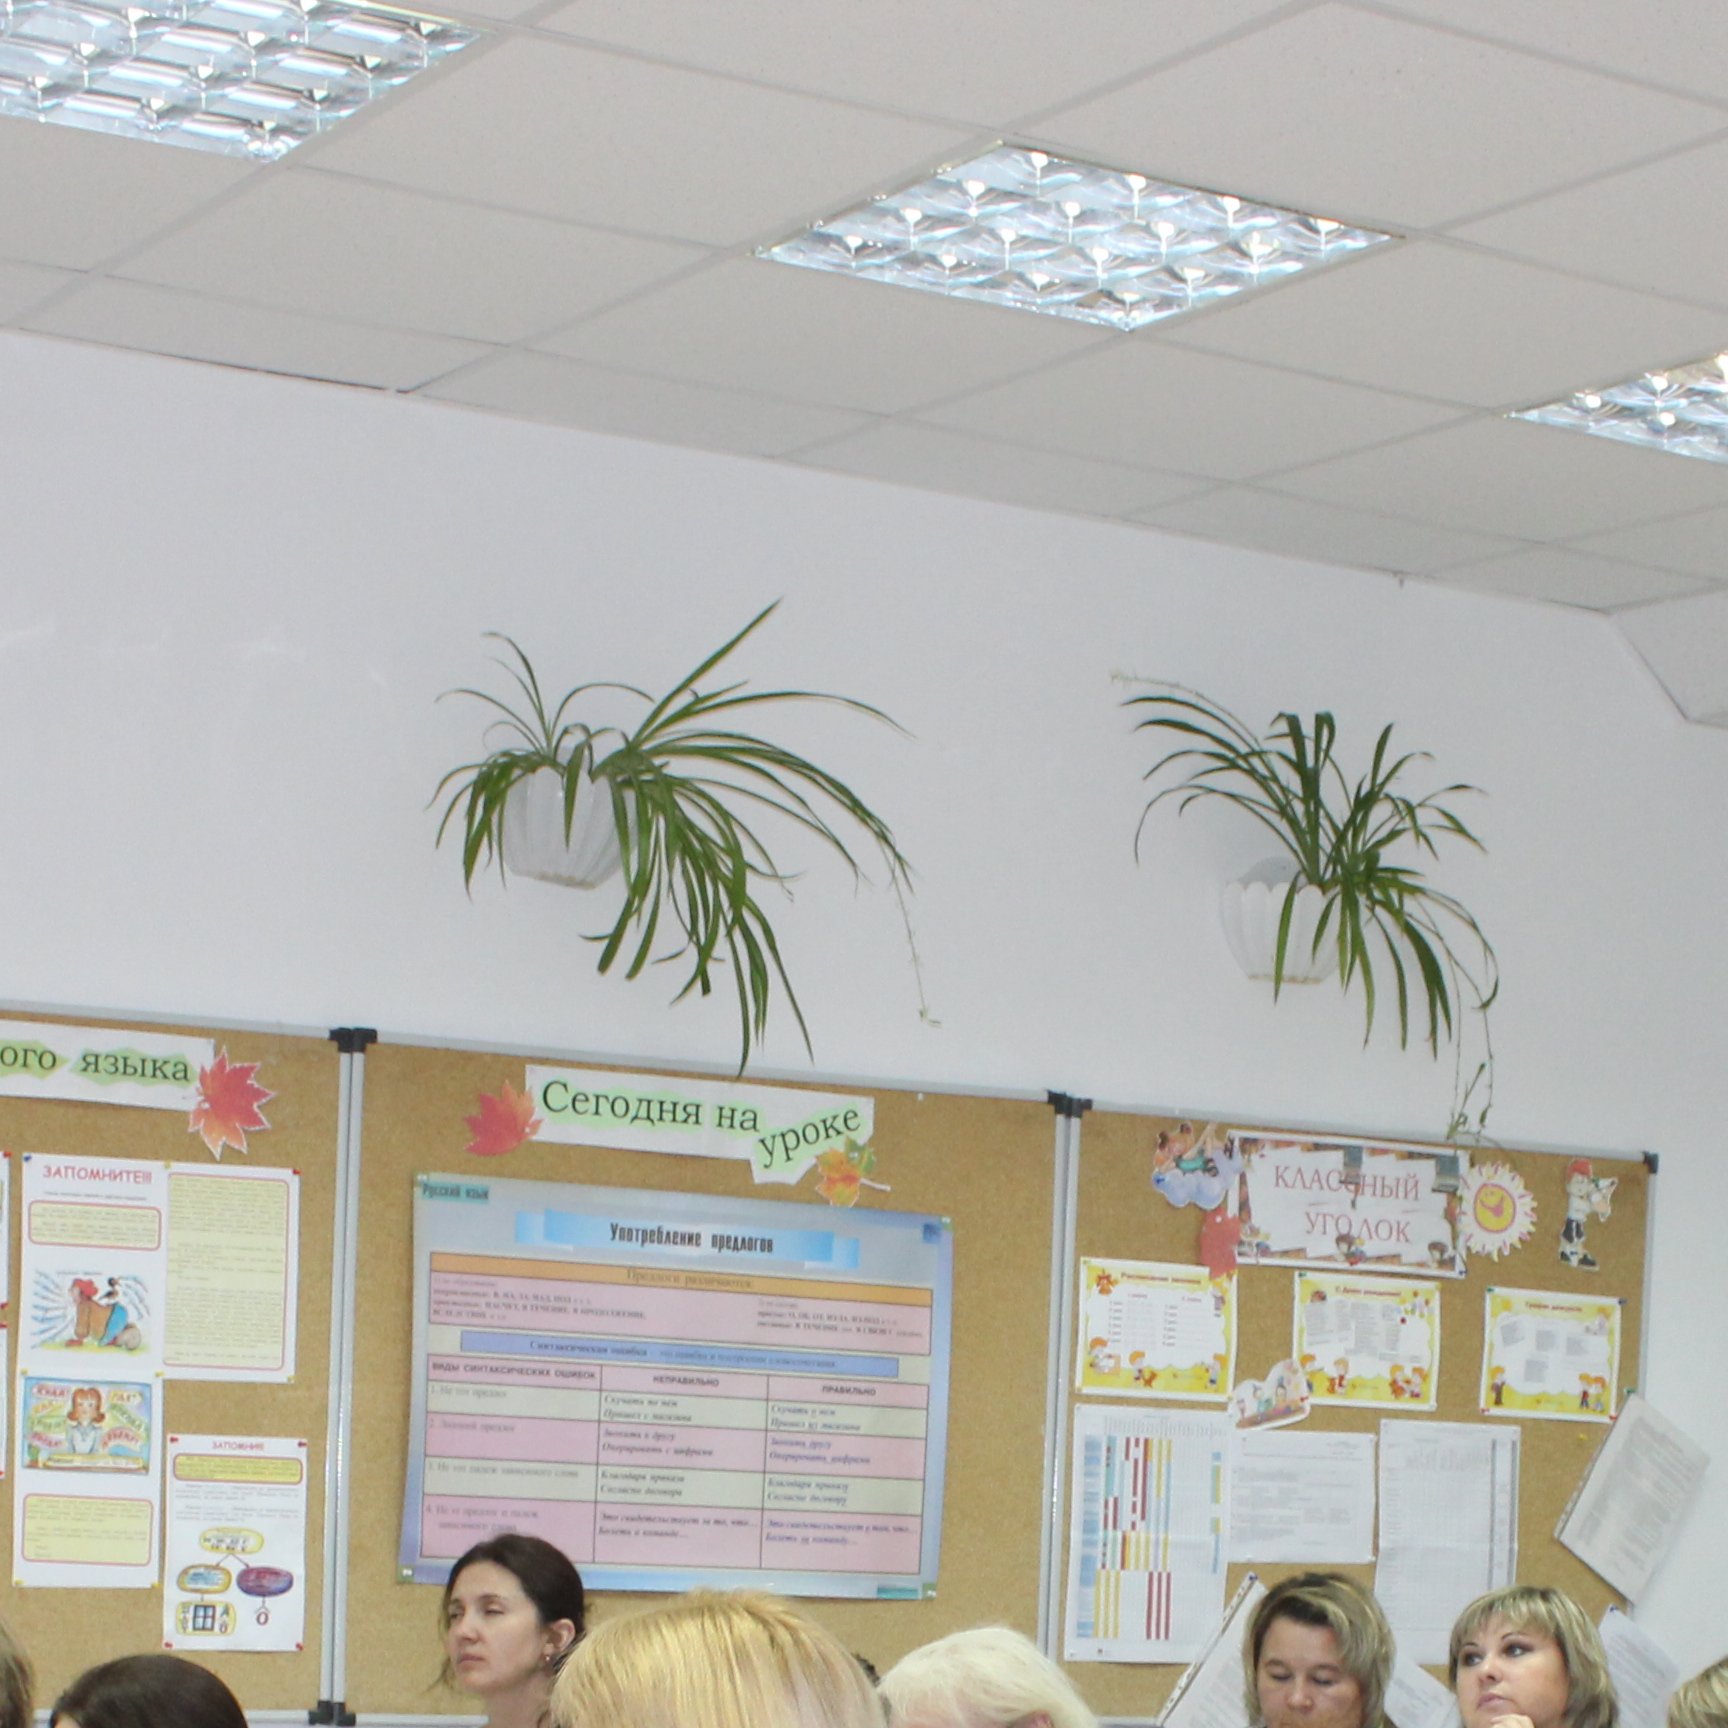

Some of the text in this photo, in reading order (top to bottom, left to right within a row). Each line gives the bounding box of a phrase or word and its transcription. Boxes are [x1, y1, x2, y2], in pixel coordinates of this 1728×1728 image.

[80, 1051, 190, 1083] языка
[542, 1081, 760, 1134] Сегодня на
[758, 1103, 862, 1169] уроке
[43, 1165, 152, 1184] ЗАПОМНИТЕ!!!
[1275, 1165, 1420, 1200] КЛАССНЫЙ
[609, 1224, 774, 1255] Употребление предлогов
[1306, 1212, 1410, 1242] УГОЛОК
[652, 1375, 719, 1388] НЕПРАВИЛЬНО
[822, 1385, 876, 1396] ПРАВИЛЬНО
